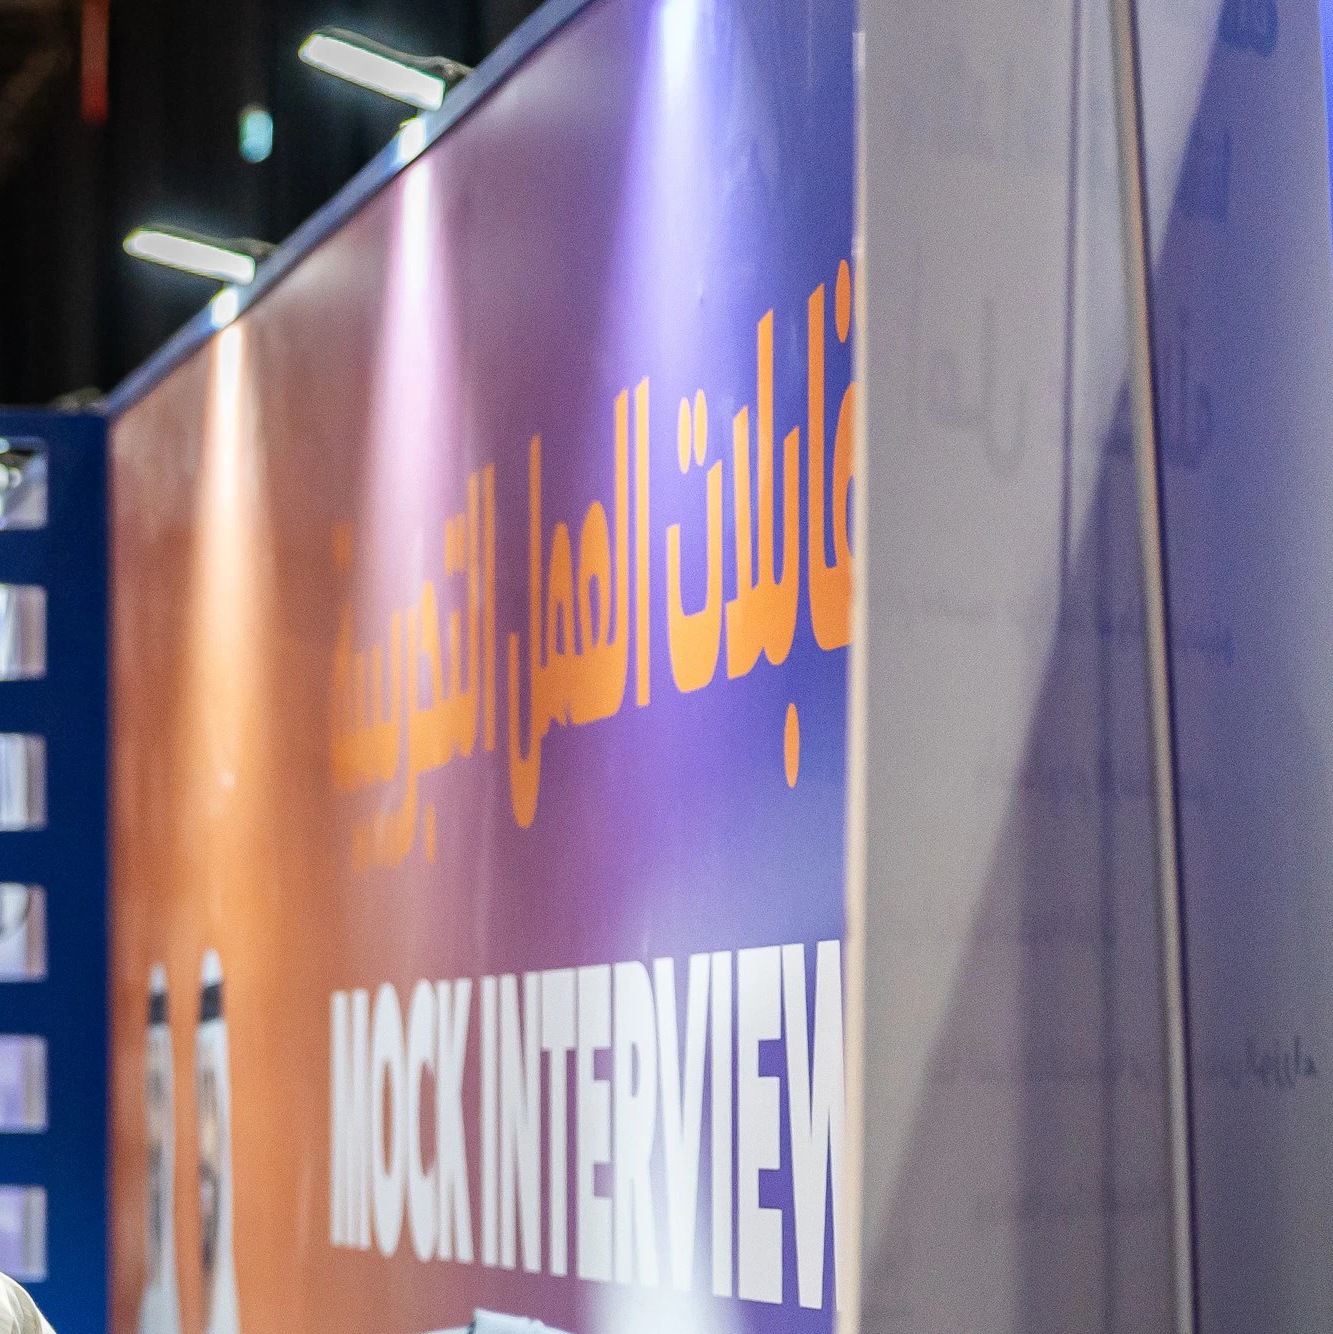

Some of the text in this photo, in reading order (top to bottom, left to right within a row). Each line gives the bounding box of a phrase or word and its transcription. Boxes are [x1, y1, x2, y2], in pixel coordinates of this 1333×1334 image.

[508, 375, 651, 829] العمل
[331, 938, 851, 1310] MOCK INTERVIEW
